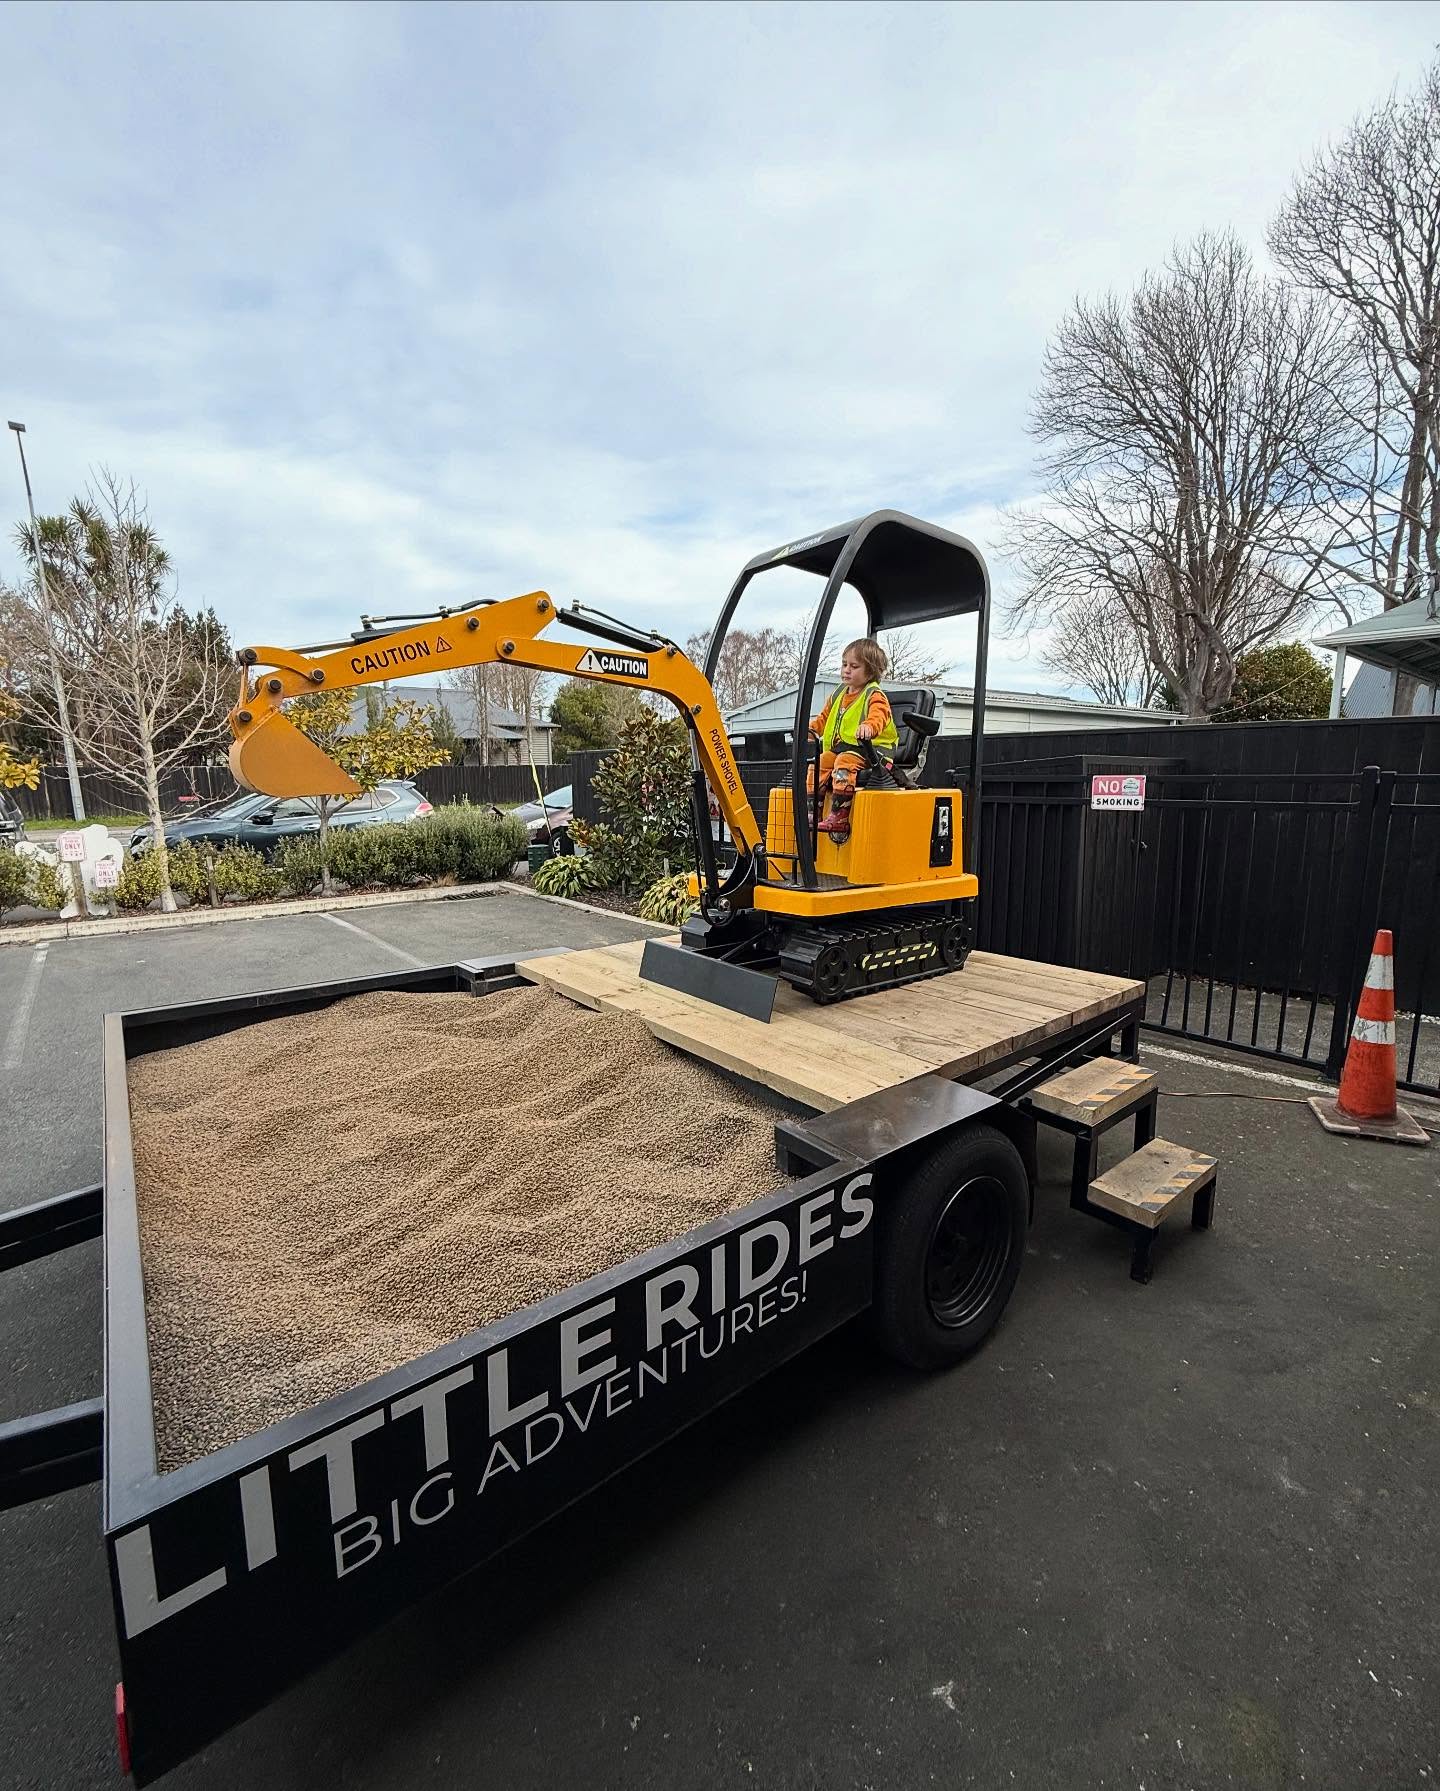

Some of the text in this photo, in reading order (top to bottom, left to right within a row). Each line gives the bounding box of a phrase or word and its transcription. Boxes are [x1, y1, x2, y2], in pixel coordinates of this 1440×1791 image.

[351, 640, 431, 675] CAUTION
[601, 656, 647, 676] CAUTION
[710, 728, 738, 795] POWER SHOVEL
[1096, 798, 1140, 806] SMOKING
[1098, 780, 1120, 794] NO
[115, 1173, 875, 1640] LITTLE RIDES
[333, 1270, 808, 1579] BIG ADVENTURES!
